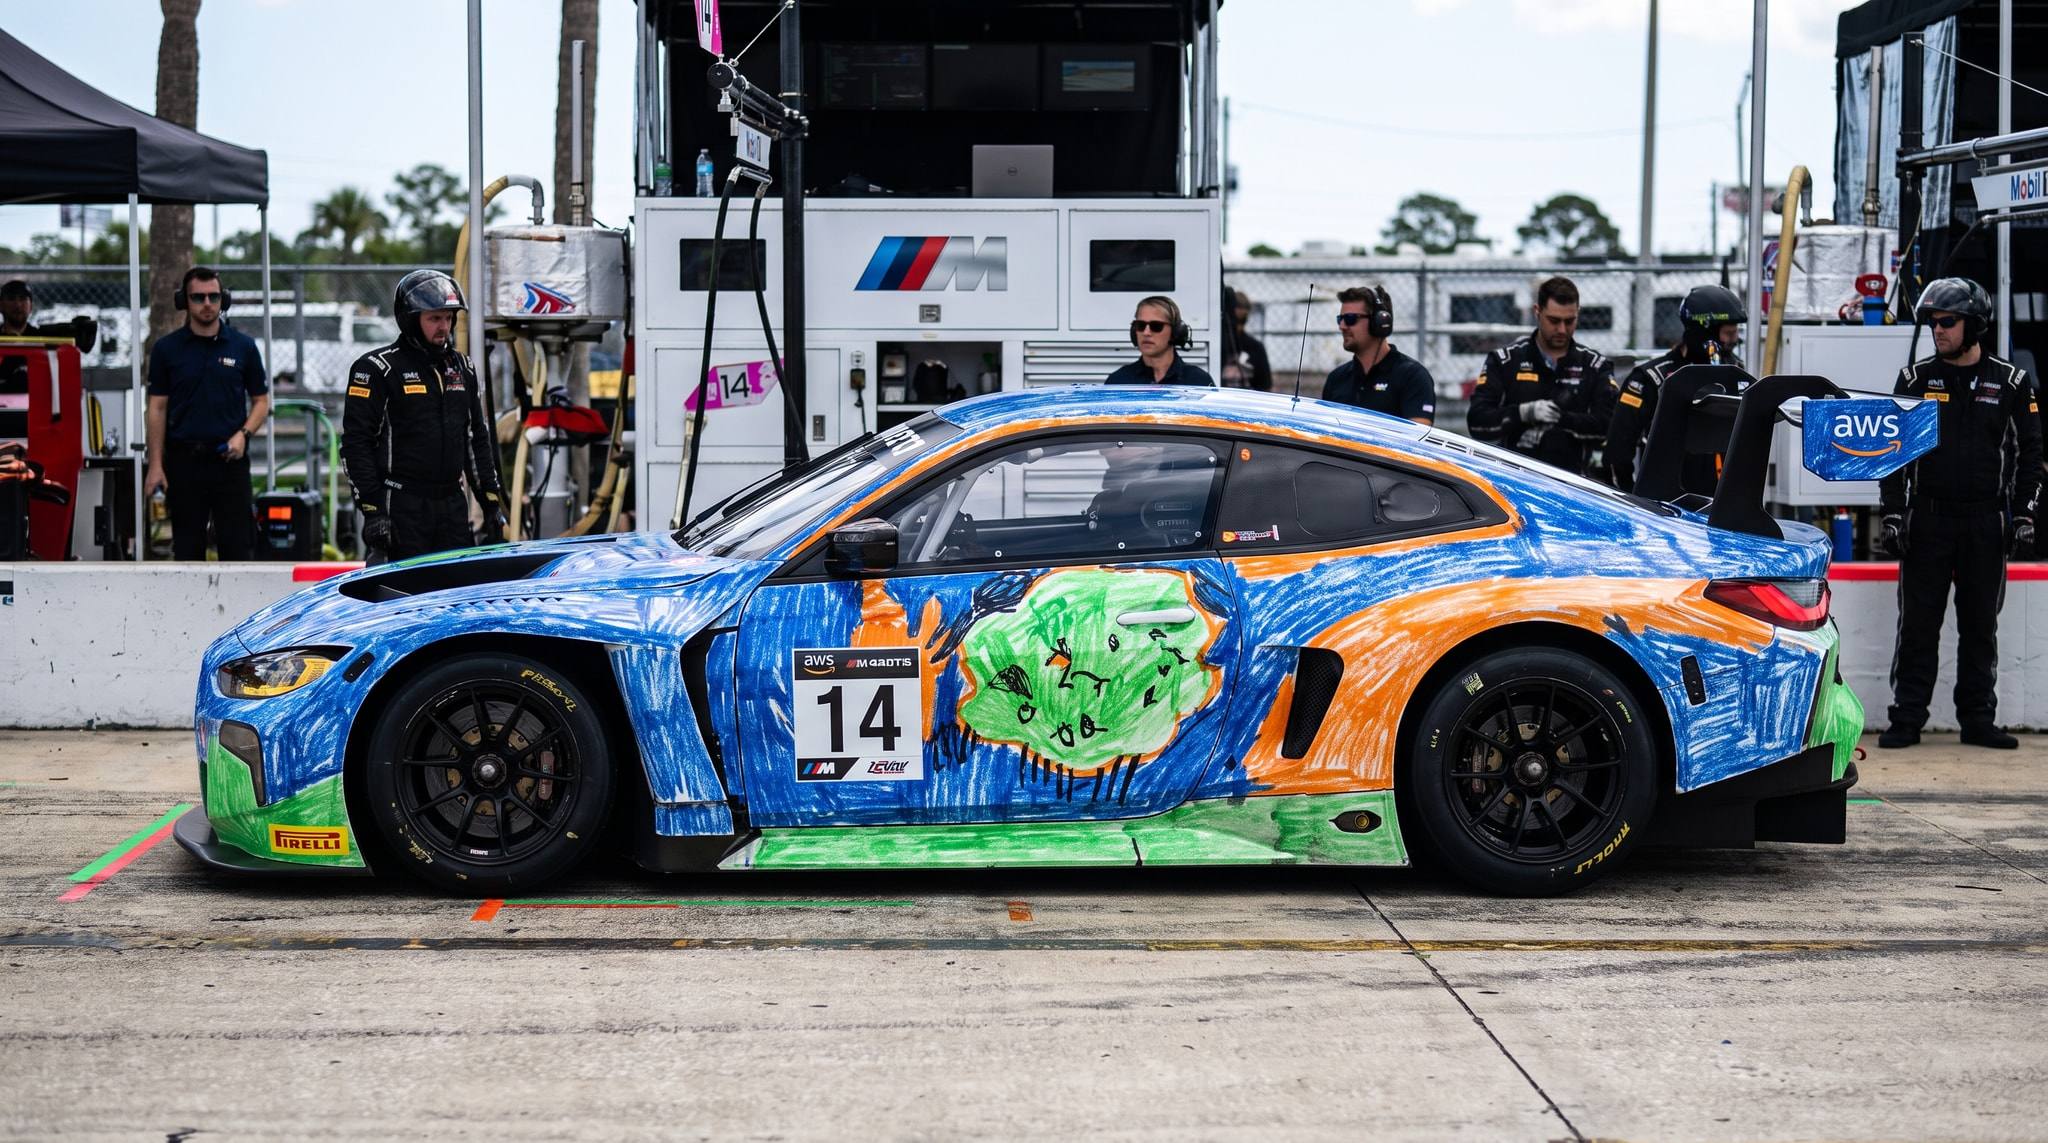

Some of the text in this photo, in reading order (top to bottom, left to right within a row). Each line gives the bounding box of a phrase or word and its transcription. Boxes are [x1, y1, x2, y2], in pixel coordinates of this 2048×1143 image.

[2010, 171, 2041, 201] Mobil
[720, 371, 750, 399] 14
[1833, 414, 1900, 438] aws
[804, 655, 835, 666] aws
[817, 684, 901, 753] 14
[274, 830, 341, 850] PIRELLI
